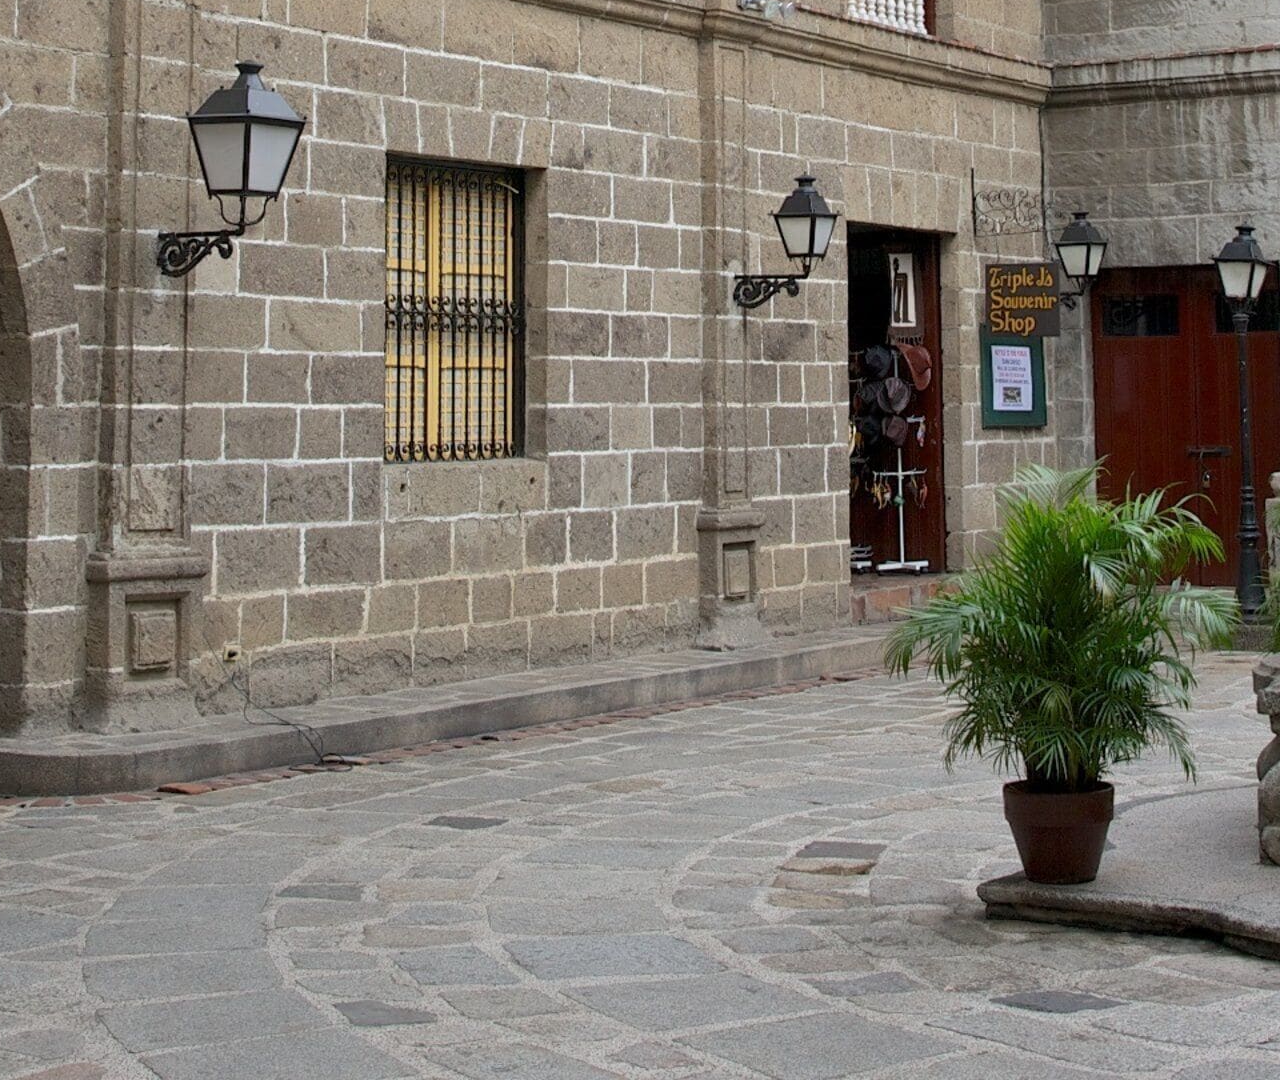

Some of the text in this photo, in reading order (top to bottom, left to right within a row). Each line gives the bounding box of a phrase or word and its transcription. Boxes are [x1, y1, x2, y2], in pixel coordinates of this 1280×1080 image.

[989, 266, 1053, 293] Triple J's
[991, 289, 1057, 309] Souvenir
[990, 310, 1036, 336] Shop
